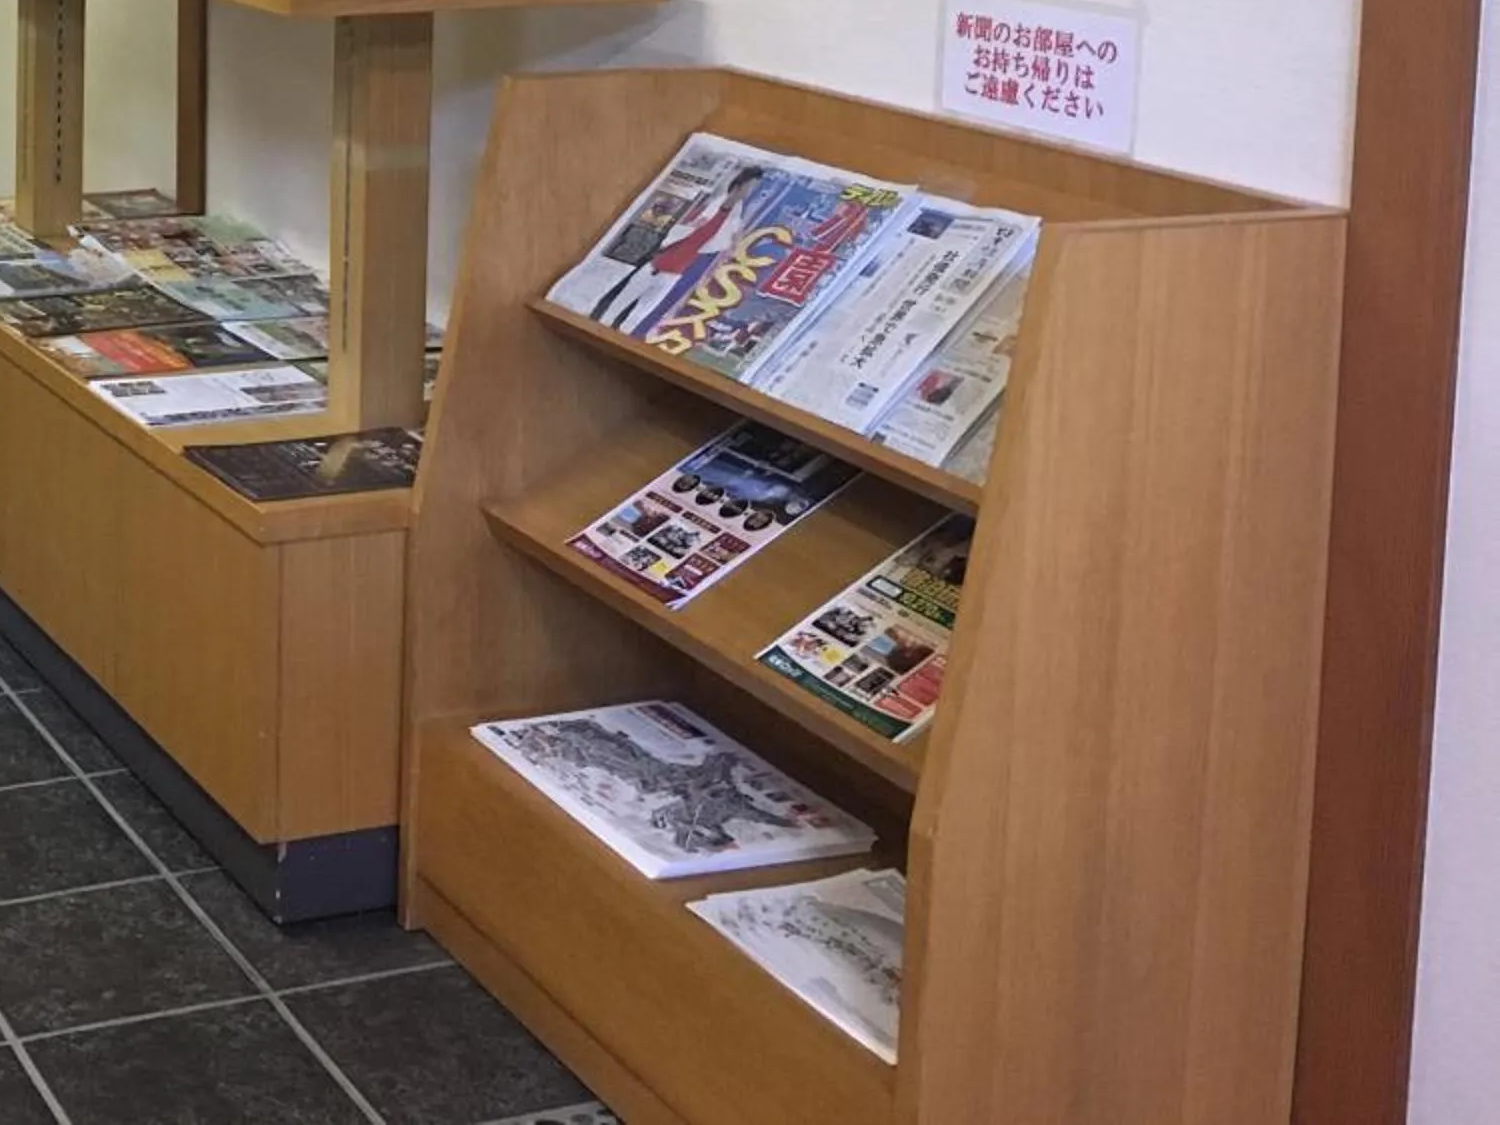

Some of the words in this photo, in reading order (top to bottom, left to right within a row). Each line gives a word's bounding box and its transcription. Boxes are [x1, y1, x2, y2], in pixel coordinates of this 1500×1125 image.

[956, 11, 1118, 64] 新聞のお部屋への
[973, 46, 1095, 90] お持ち帰りは
[965, 72, 1104, 119] ご遠慮ください
